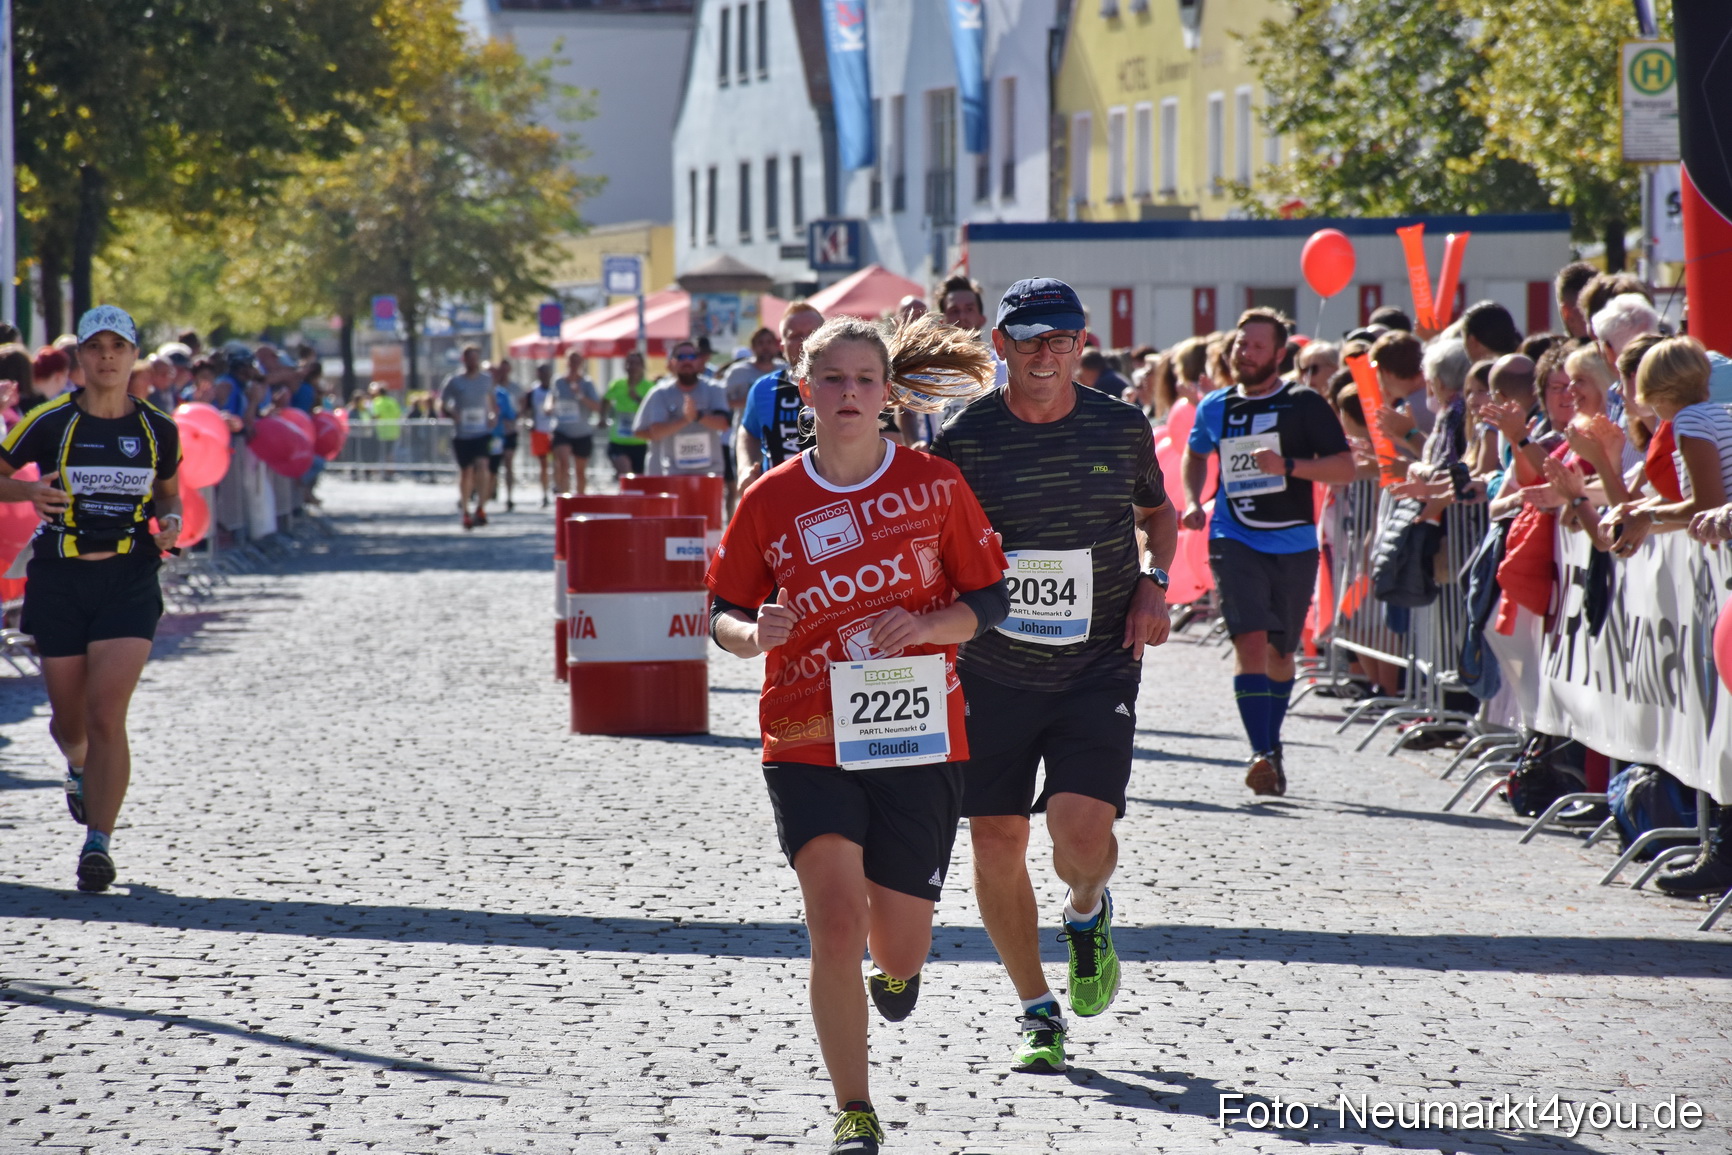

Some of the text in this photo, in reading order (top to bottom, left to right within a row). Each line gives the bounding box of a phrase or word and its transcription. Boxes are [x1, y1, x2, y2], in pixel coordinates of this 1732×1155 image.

[72, 471, 148, 487] Nepro Sport
[800, 505, 848, 528] raumbox
[871, 516, 930, 541] schenken
[1018, 560, 1063, 570] BOCK
[1007, 577, 1077, 606] 2034
[807, 604, 855, 631] wohnen
[865, 587, 914, 608] outdoor
[1018, 621, 1062, 635] Johann
[864, 667, 914, 682] BOCK
[850, 686, 930, 725] 2225
[860, 725, 918, 736] PARTL Neumarkt
[869, 740, 919, 757] Claudia
